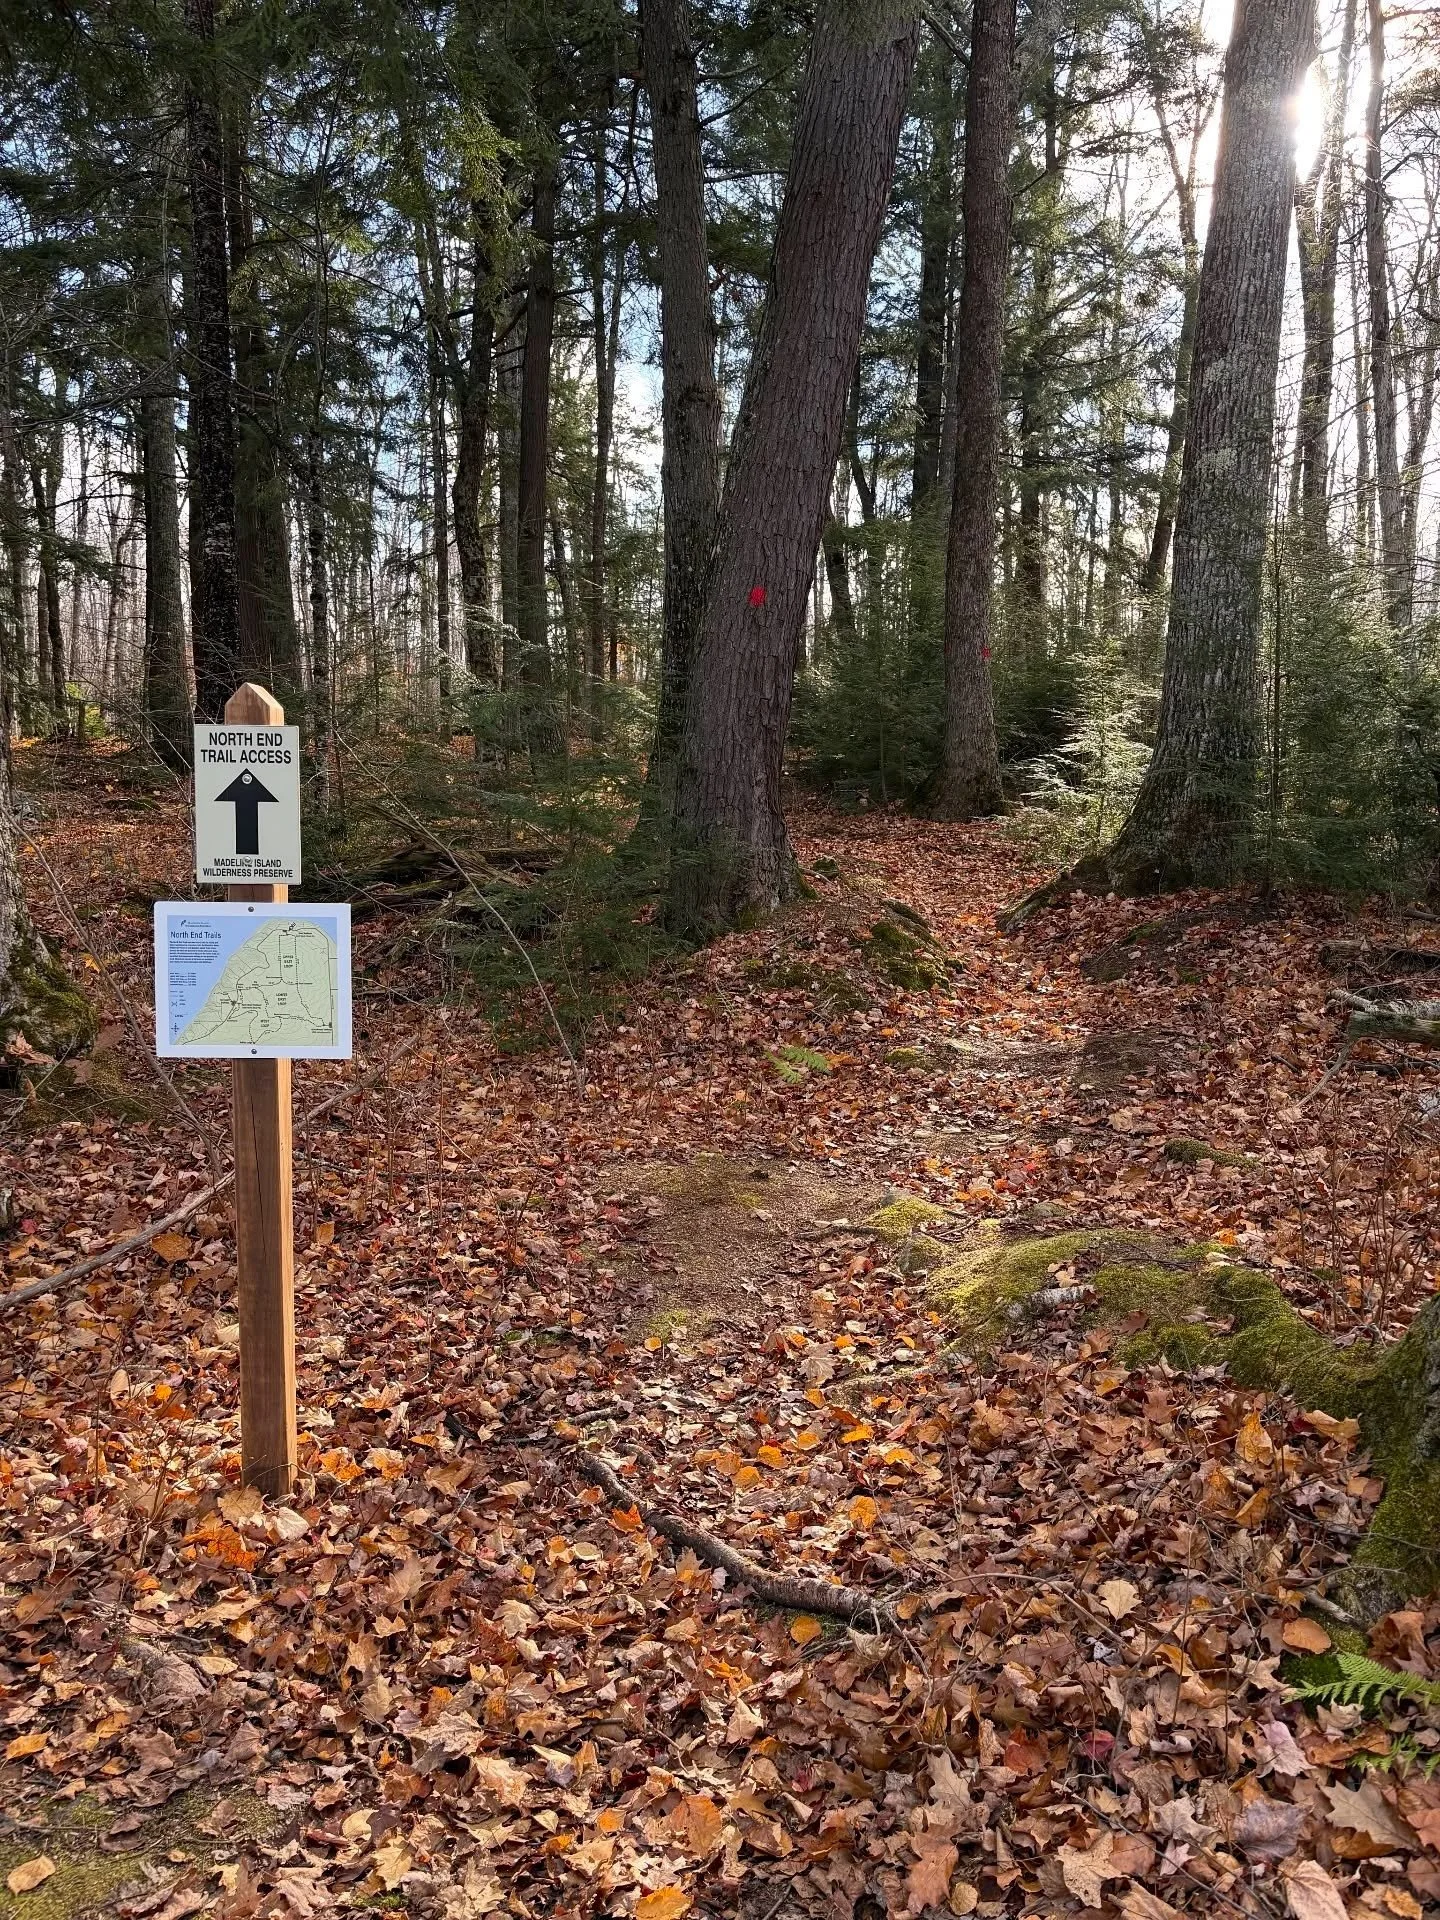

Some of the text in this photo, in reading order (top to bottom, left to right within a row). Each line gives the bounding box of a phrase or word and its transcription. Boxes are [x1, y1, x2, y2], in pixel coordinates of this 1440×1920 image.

[209, 732, 283, 746] NORTH END
[201, 749, 292, 764] TRAIL ACCESS
[254, 859, 282, 868] ISLAND
[203, 868, 293, 878] WILDERNESS PRESERVE
[170, 931, 222, 939] North End Trails
